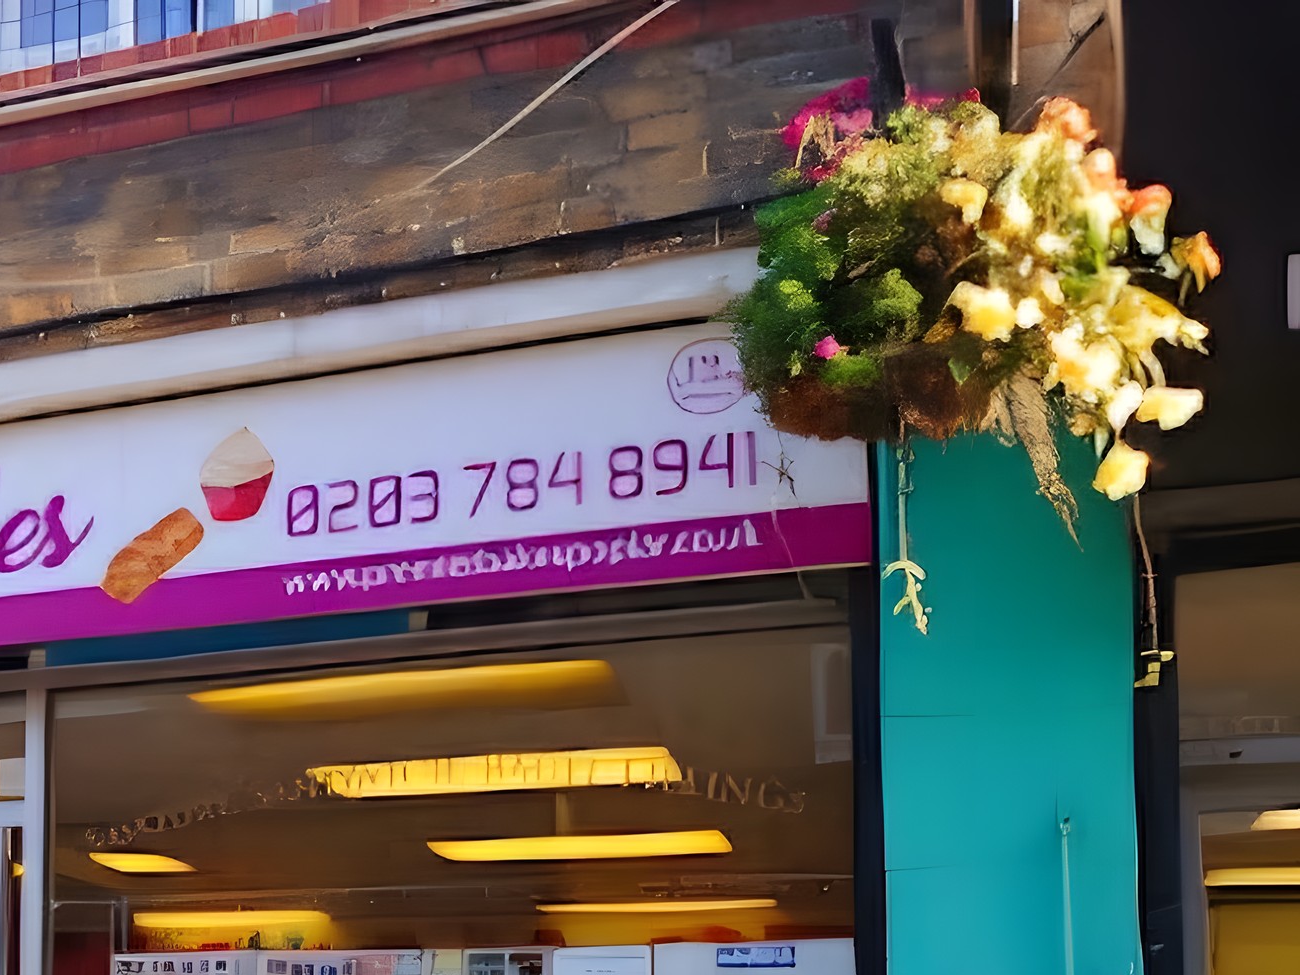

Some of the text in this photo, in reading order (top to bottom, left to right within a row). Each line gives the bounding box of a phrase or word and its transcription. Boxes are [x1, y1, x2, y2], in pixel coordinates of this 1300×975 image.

[287, 431, 757, 537] 0203 784 8941
